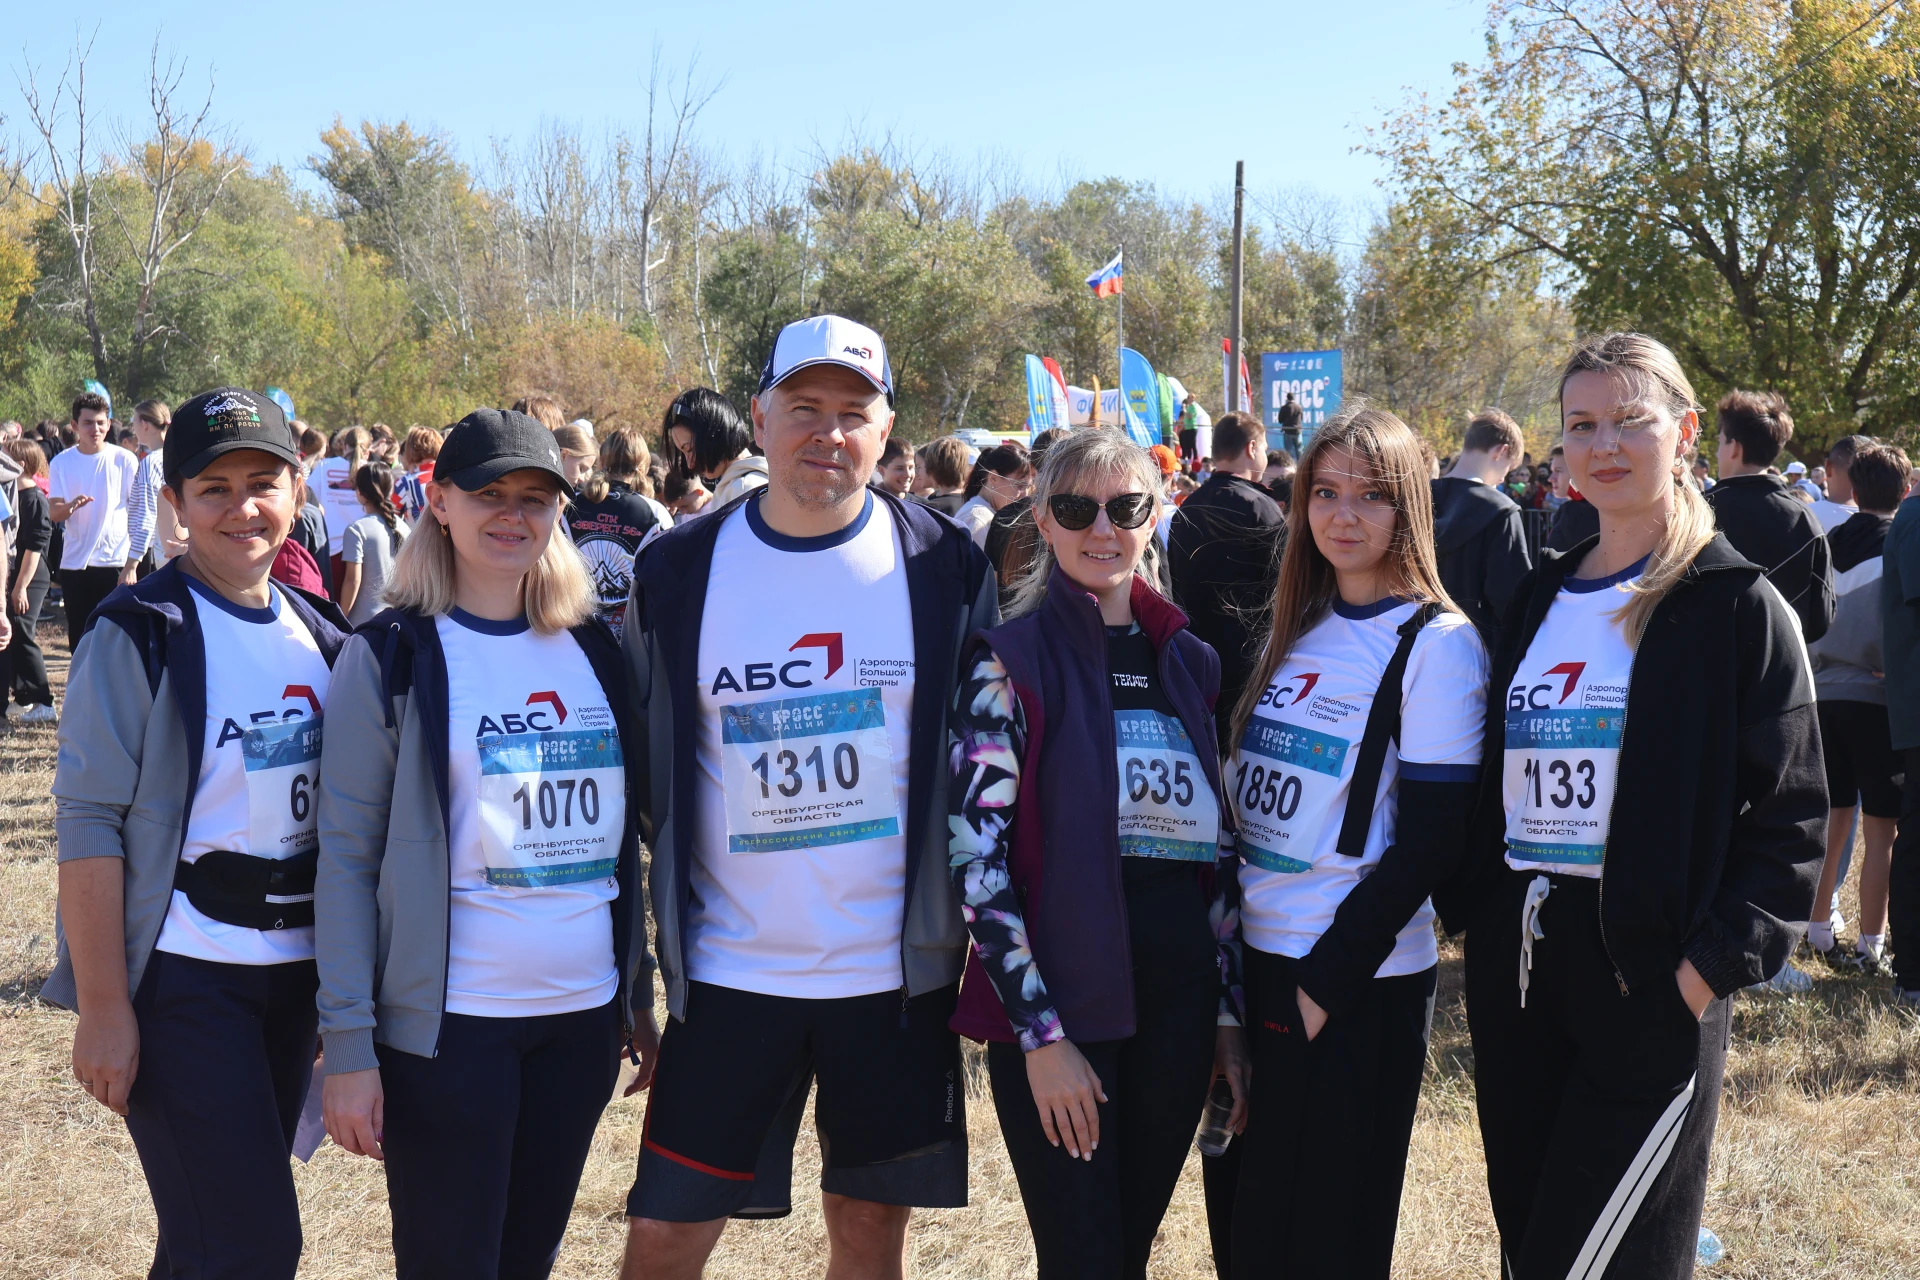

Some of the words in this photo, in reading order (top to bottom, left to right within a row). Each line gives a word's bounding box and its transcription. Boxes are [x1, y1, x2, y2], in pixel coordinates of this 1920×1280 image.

[843, 346, 868, 359] АБС
[1272, 411, 1324, 424] НИИ
[596, 513, 618, 524] СТК
[712, 660, 813, 695] АБС
[860, 668, 906, 676] Большой
[860, 678, 898, 686] Страны
[1586, 684, 1628, 694] Аэропор
[1258, 684, 1294, 708] БС
[1508, 684, 1553, 712] БС
[1312, 702, 1348, 718] Большой
[1316, 696, 1360, 712] Аэропорты
[772, 706, 822, 724] КРОСС
[1310, 710, 1338, 724] Страны
[476, 711, 554, 738] АБС
[774, 721, 824, 732] НАЦИИ
[1120, 720, 1166, 734] КРОСС
[1530, 718, 1572, 732] КРОСС
[302, 729, 323, 747] КРО
[1123, 733, 1168, 742] НАЦИИ
[1262, 726, 1294, 748] КРОСС
[535, 740, 577, 756] КРОСС
[1260, 741, 1290, 755] НАЦИИ
[536, 756, 577, 764] НАЦИИ
[751, 742, 860, 798] 1310
[1126, 758, 1194, 806] 635
[1236, 761, 1302, 820] 1850
[513, 778, 600, 830] 1070
[752, 799, 864, 818] ОРЕНБУРГСКАЯ
[773, 812, 842, 824] ОБЛАСТЬ
[1119, 814, 1196, 826] ЕНБУРГСКАЯ
[1521, 818, 1598, 827] РЕНБУРГСКАЯ
[1120, 822, 1175, 832] ОБЛАСТЬ
[1240, 818, 1290, 840] НБУРГСКАЯ
[1526, 828, 1578, 836] ОБЛАСТЬ
[739, 832, 823, 846] ВСЕРОССИЙСКИЙ
[830, 828, 856, 838] ДЕНЬ
[860, 824, 884, 833] БЕГА
[513, 836, 605, 851] ОРЕНБУРГСКАЯ
[1156, 842, 1180, 850] ДЕНЬ
[534, 848, 588, 858] ОБЛАСТЬ
[1278, 860, 1300, 869] БЕГА
[495, 868, 575, 879] ВСЕРОССИЙСКИЙ
[578, 866, 596, 874] ДЕНЬ
[944, 1082, 954, 1122] Reebok
